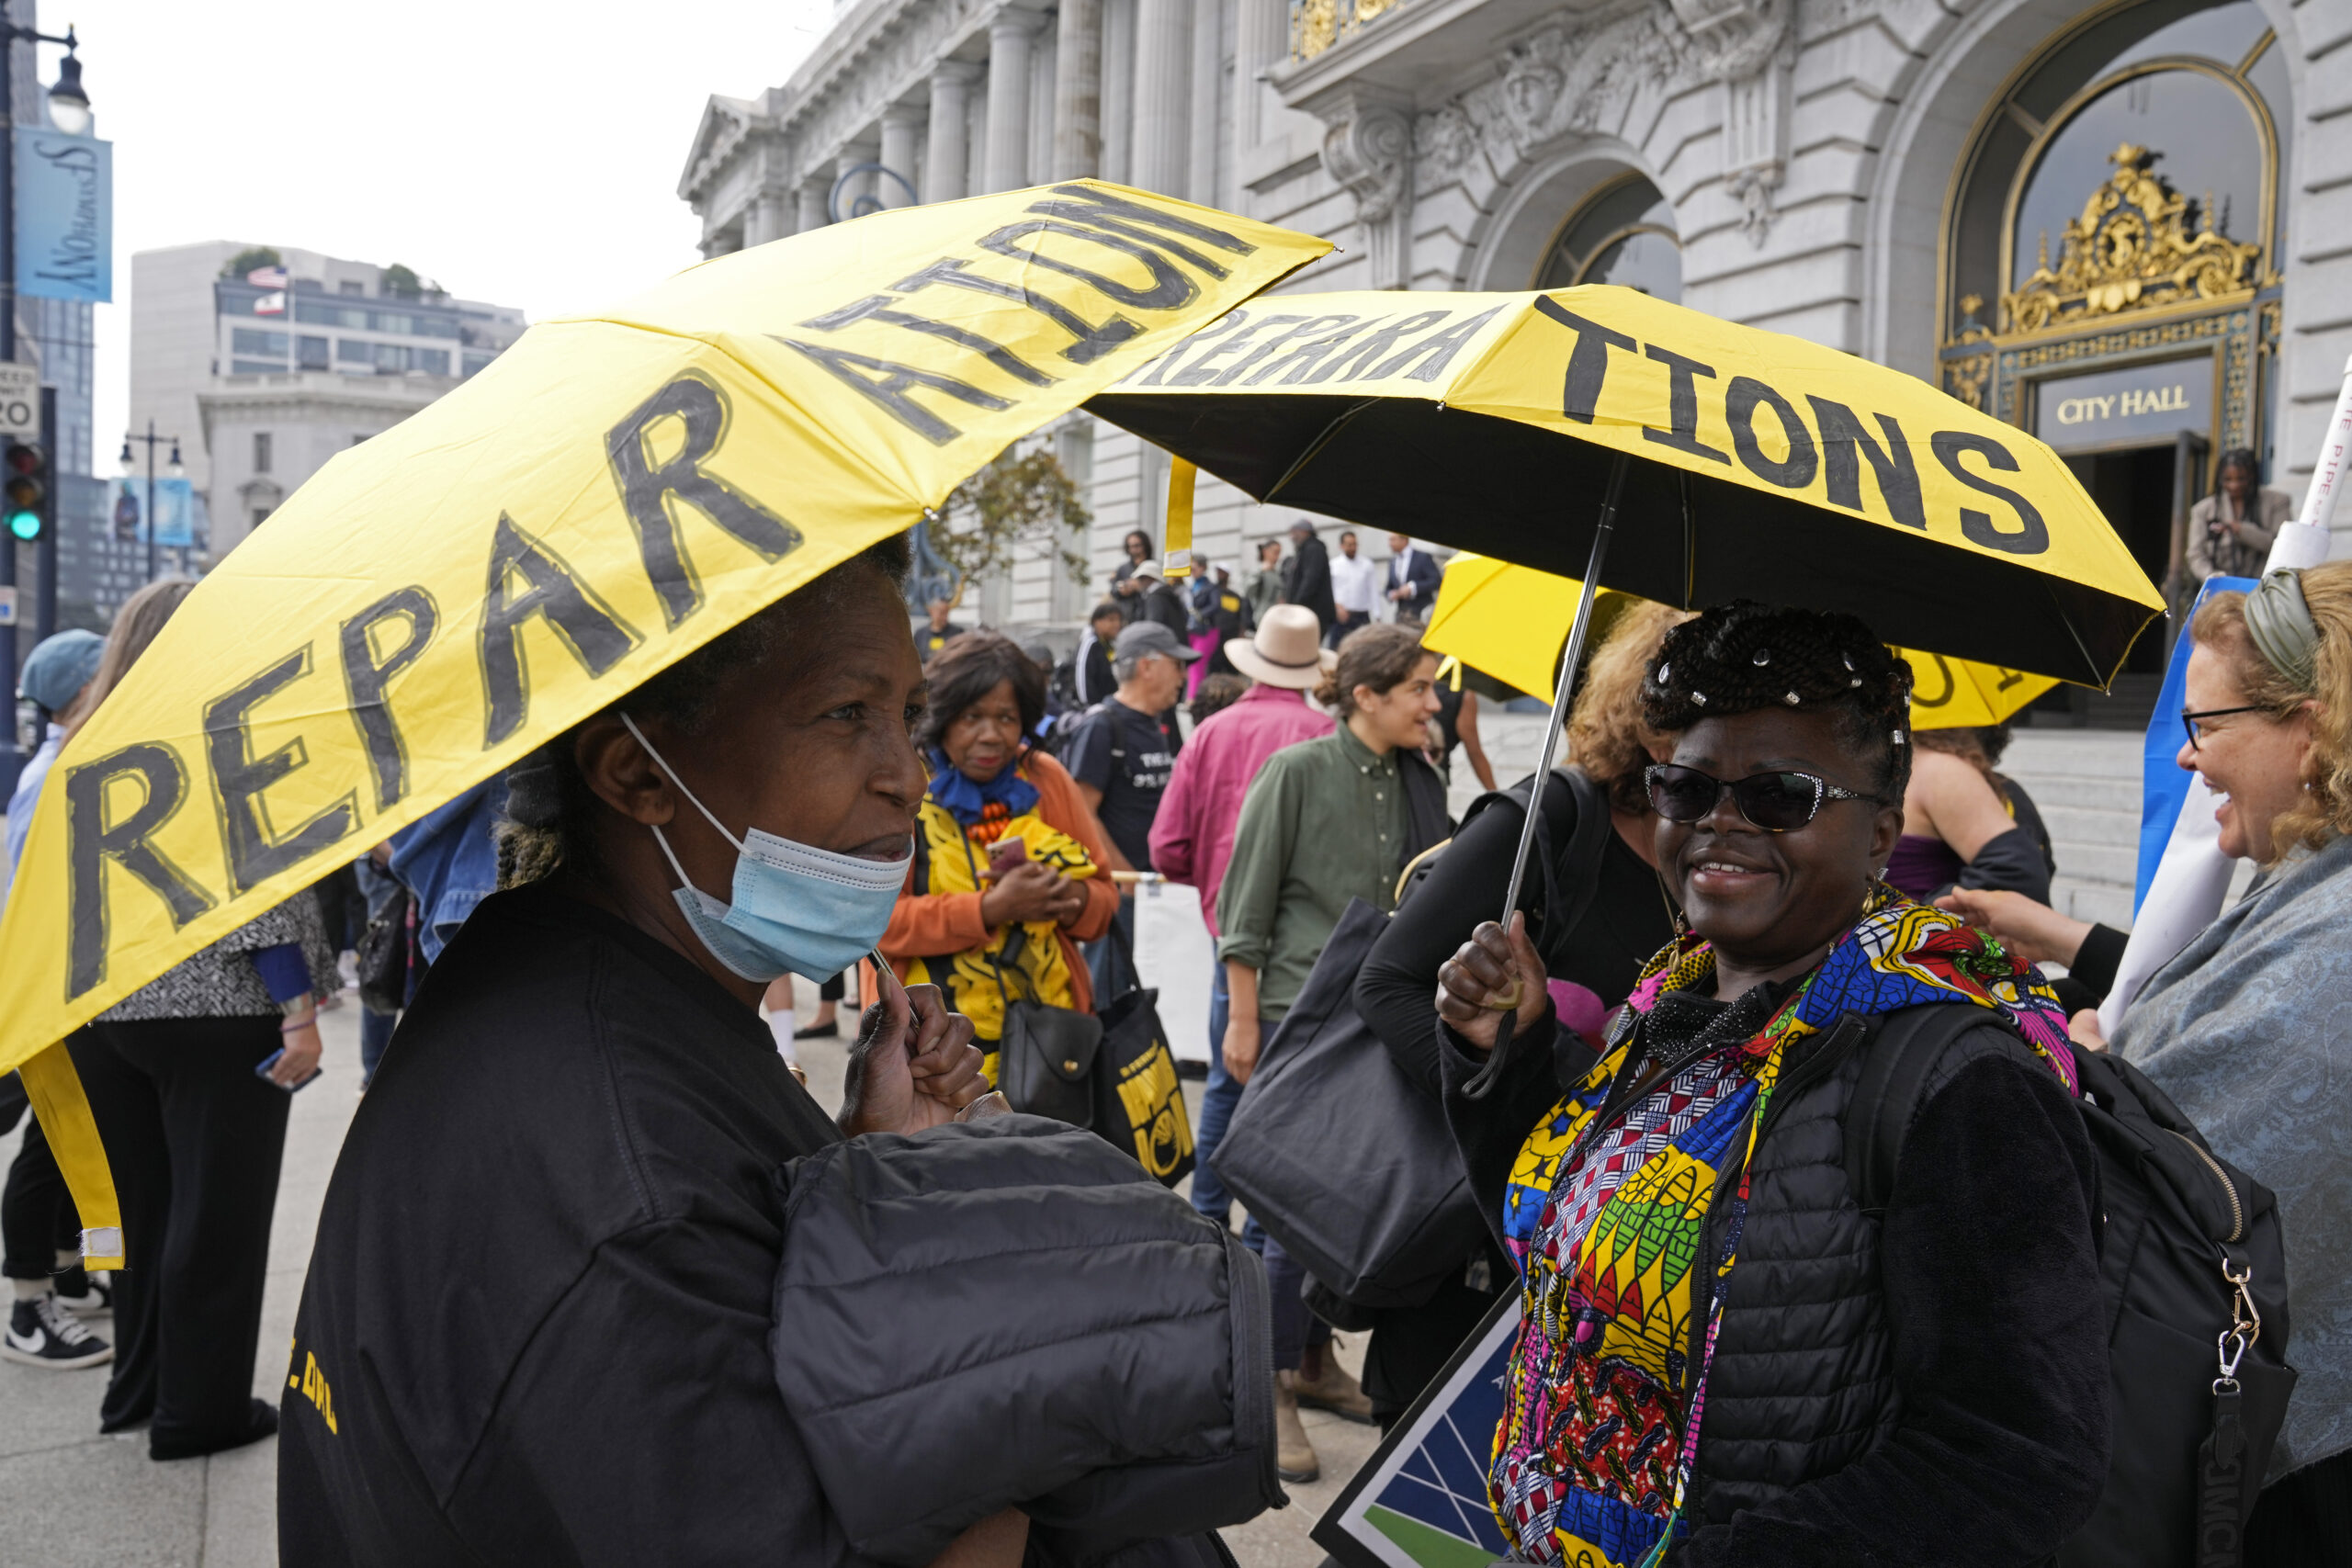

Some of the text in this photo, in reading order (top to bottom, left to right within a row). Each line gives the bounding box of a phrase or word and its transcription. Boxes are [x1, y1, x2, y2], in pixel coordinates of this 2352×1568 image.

[2057, 385, 2189, 424] CITY HALL
[2318, 445, 2344, 496] PIPE
